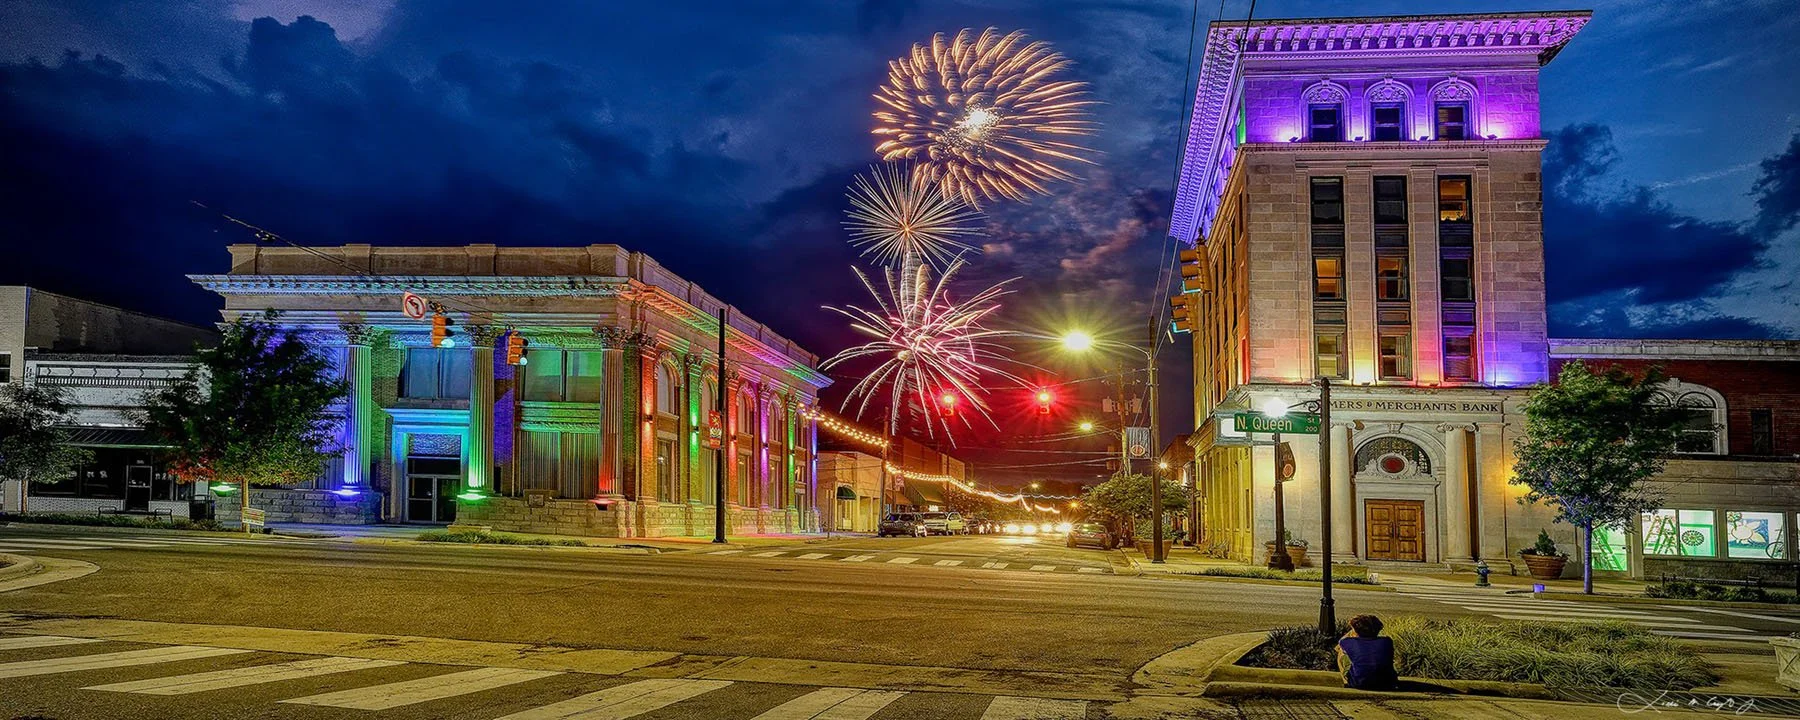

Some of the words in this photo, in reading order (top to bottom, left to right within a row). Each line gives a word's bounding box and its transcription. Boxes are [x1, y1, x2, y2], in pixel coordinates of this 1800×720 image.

[1329, 400, 1363, 410] MERS
[1375, 401, 1457, 411] MERCHANTS
[1463, 403, 1499, 412] BANK
[1236, 416, 1248, 430] N.
[1252, 417, 1293, 432] Queen
